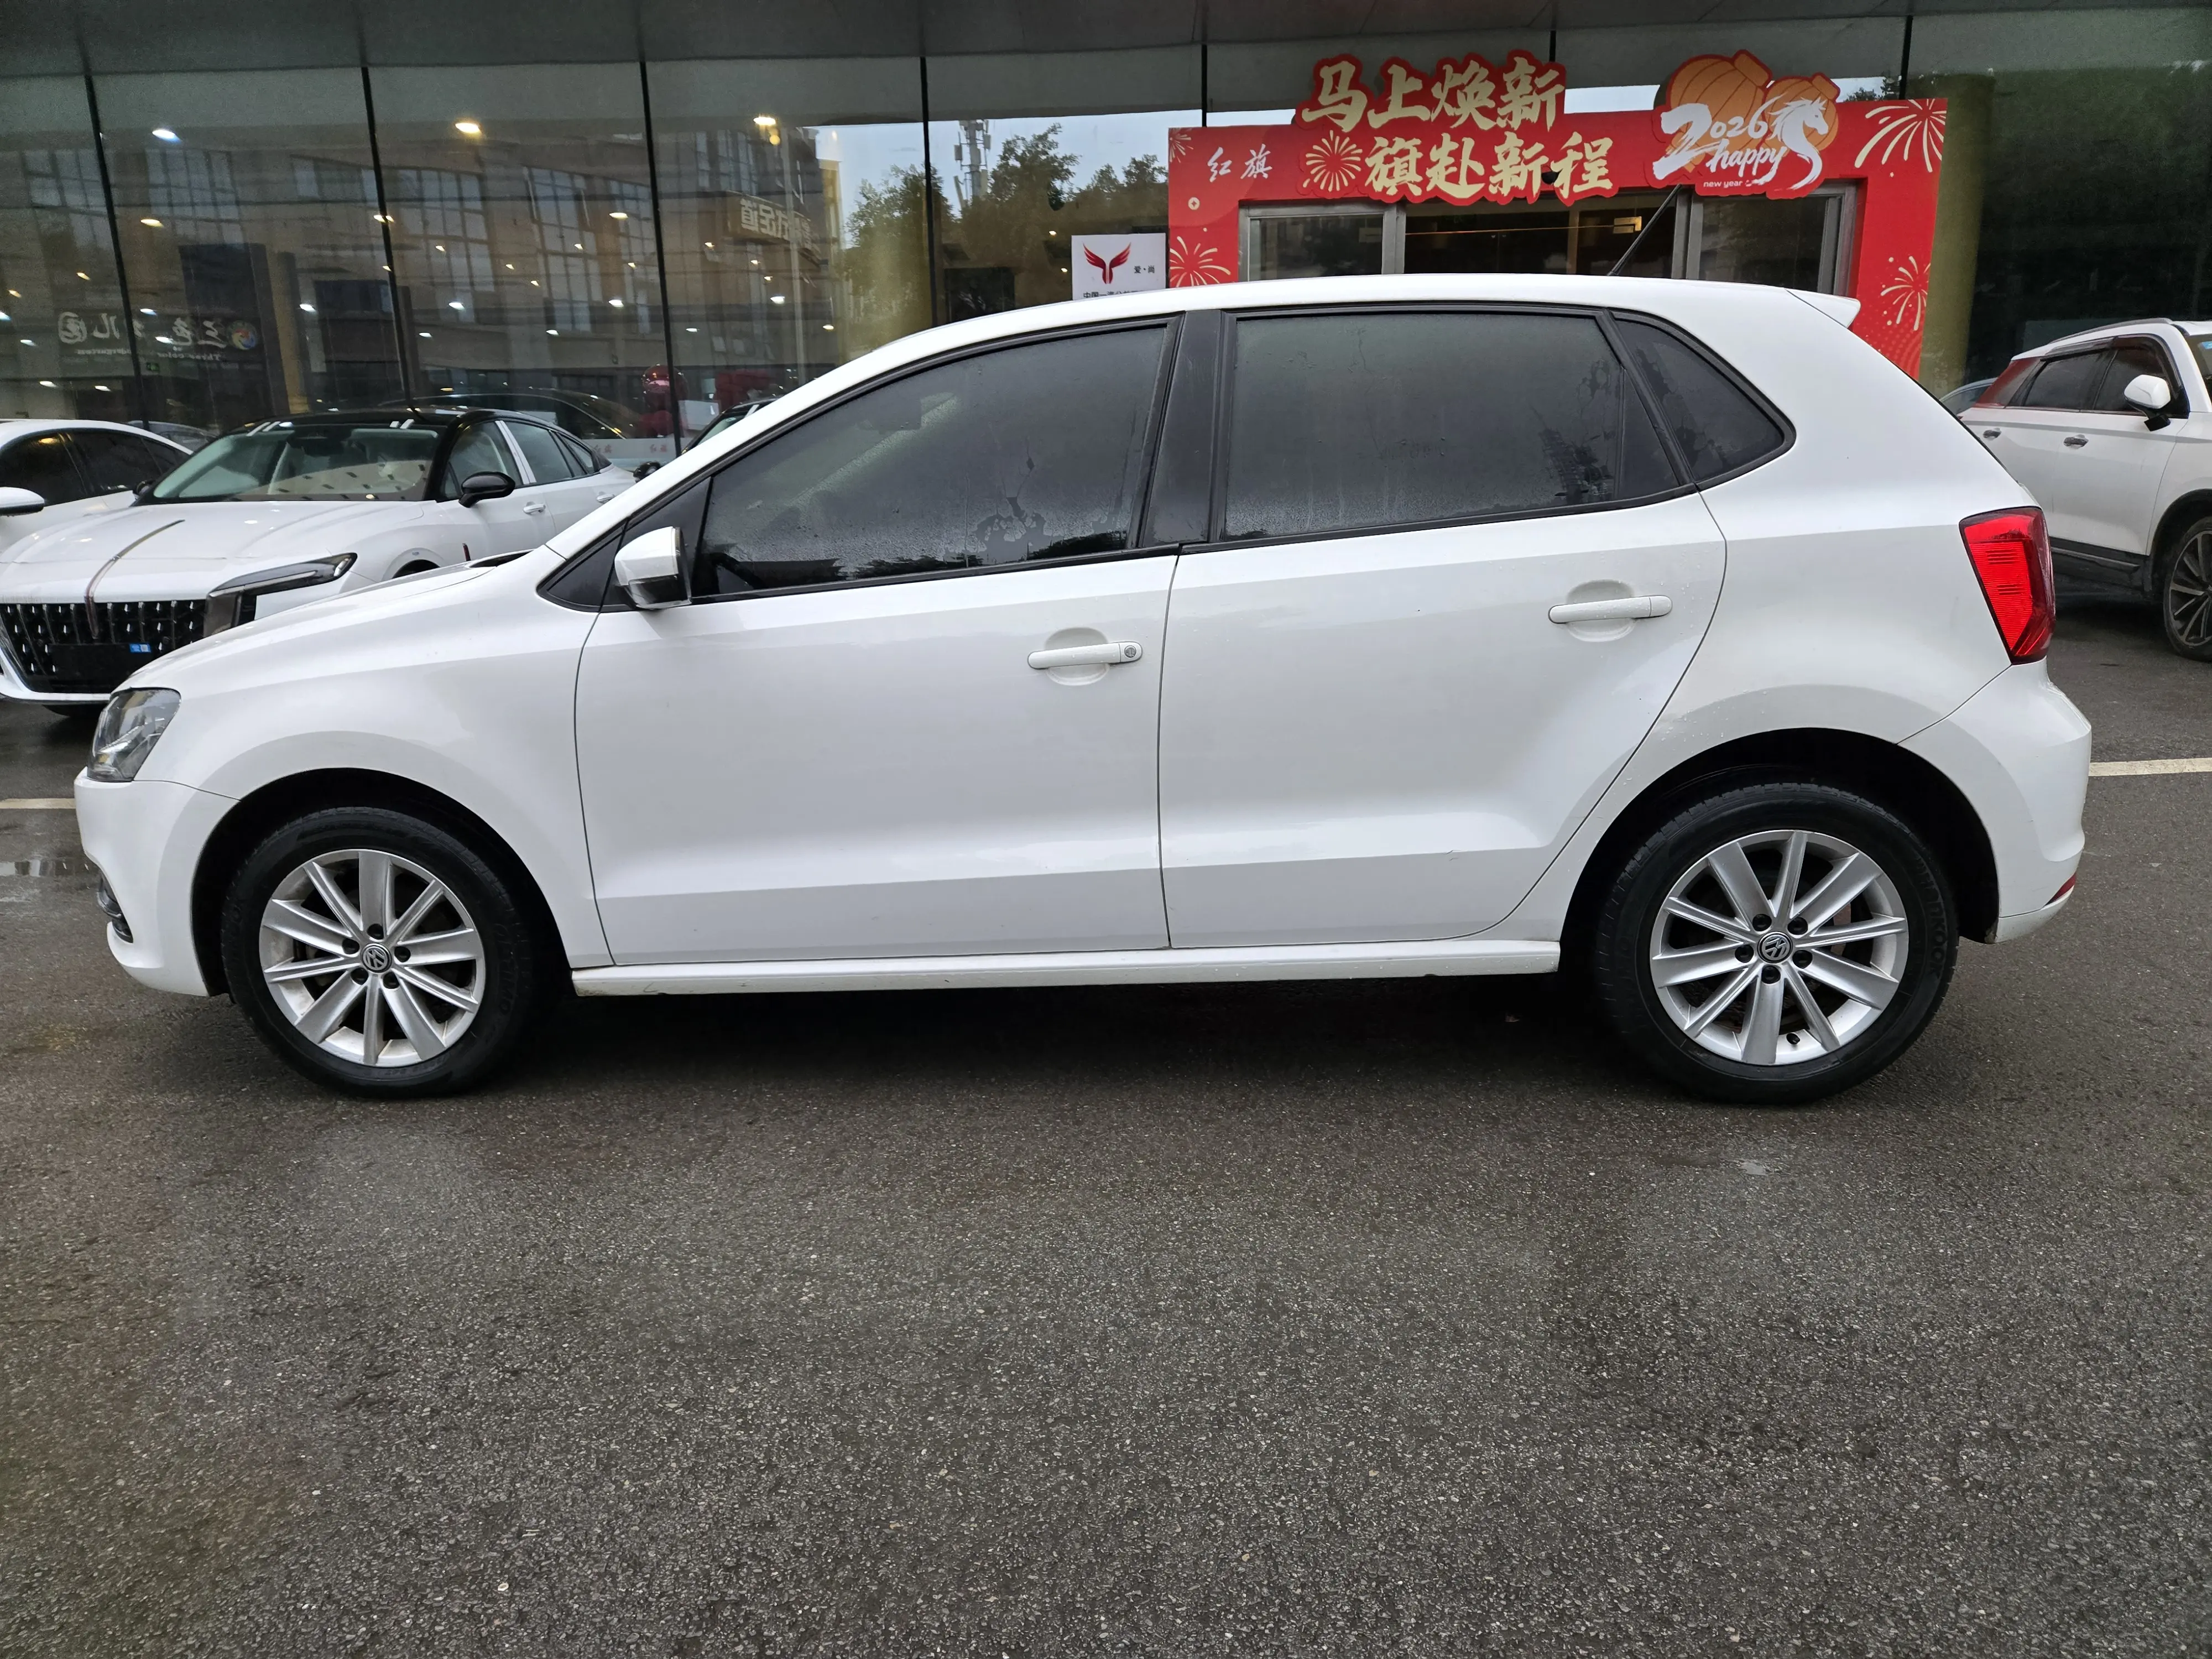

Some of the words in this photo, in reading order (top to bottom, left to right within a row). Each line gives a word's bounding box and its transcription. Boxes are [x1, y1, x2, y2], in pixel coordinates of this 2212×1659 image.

[1302, 56, 1565, 133] 马上焕新
[1207, 143, 1272, 182] 红旗
[1364, 131, 1614, 200] 旗赴新程
[1653, 94, 1783, 180] 2026
